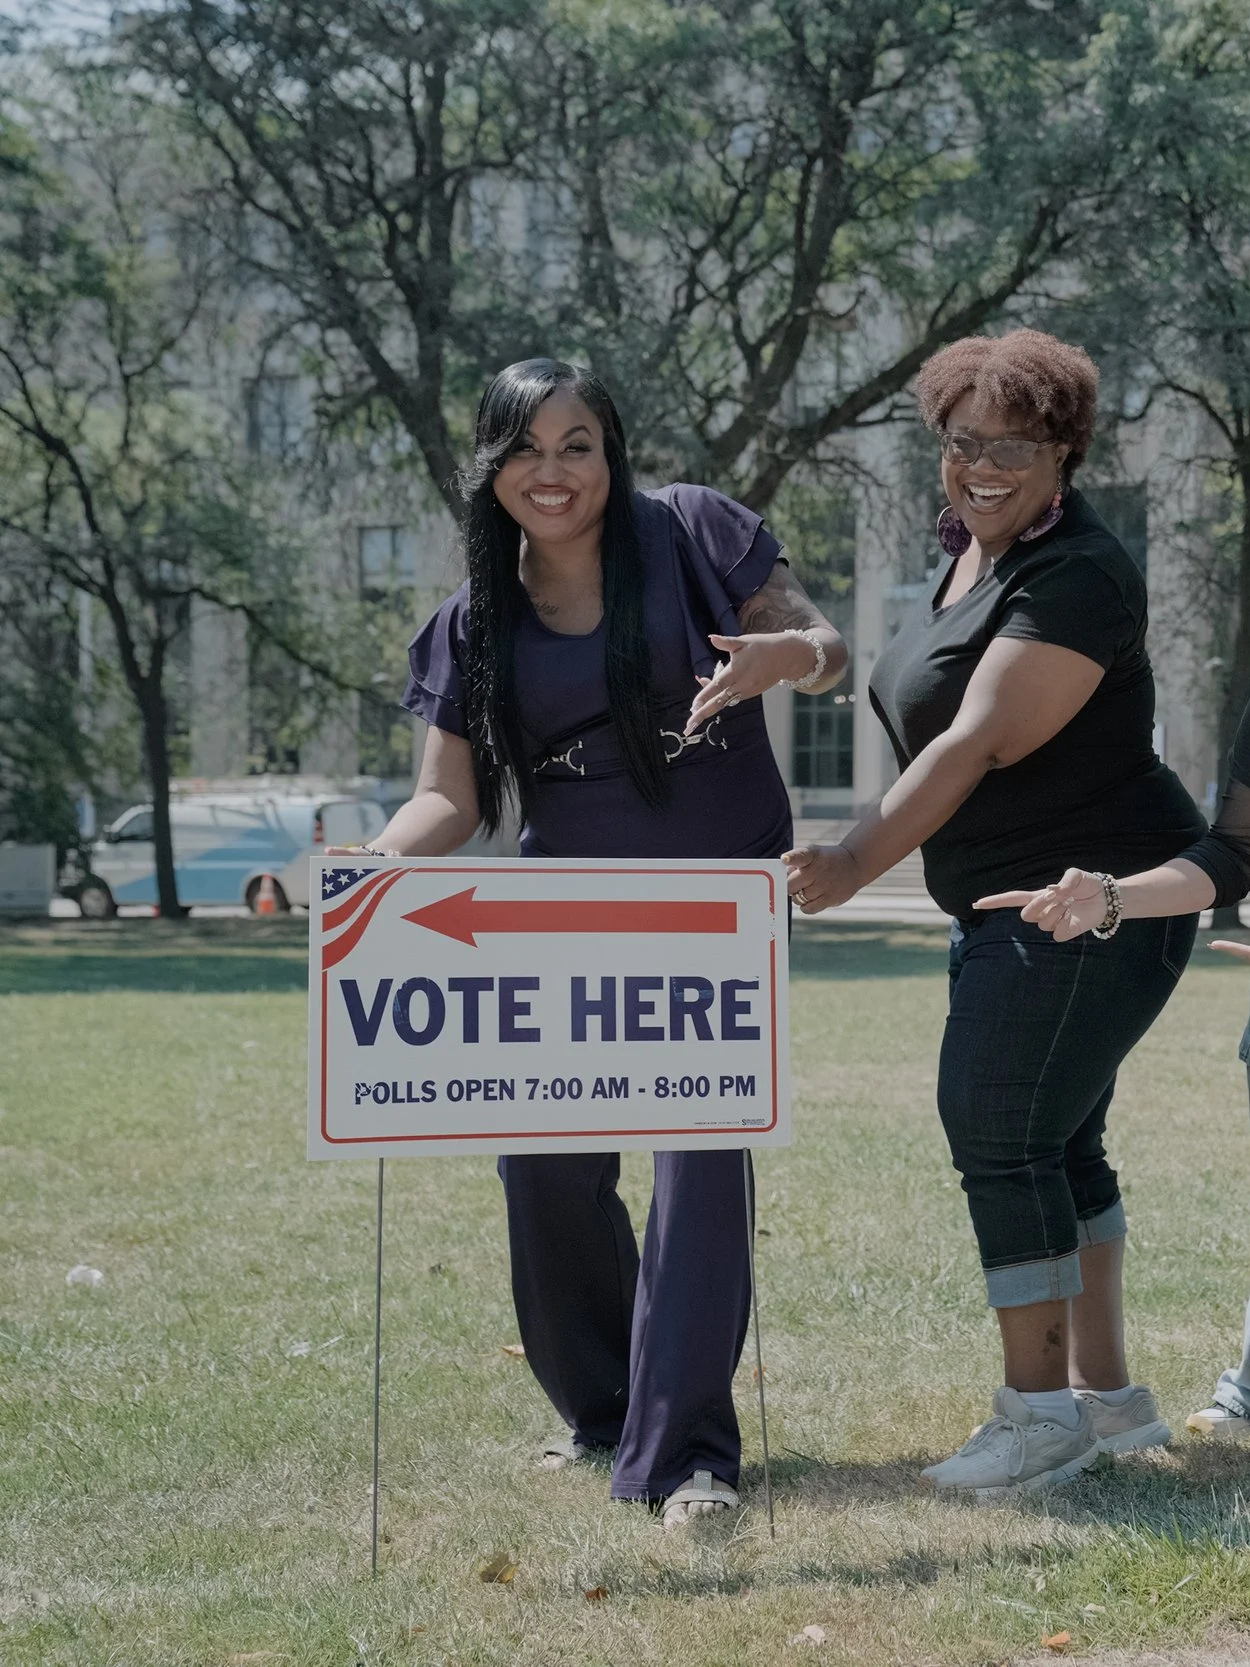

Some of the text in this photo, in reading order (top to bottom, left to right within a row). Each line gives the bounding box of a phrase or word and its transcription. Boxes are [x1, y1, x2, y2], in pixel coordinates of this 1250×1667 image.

[339, 975, 761, 1047] VOTE HERE
[355, 1079, 437, 1105] POLLS
[446, 1078, 515, 1102] OPEN
[525, 1077, 583, 1100] 7:00
[591, 1076, 629, 1099] AM
[654, 1075, 710, 1099] 8:00
[719, 1074, 756, 1097] PM
